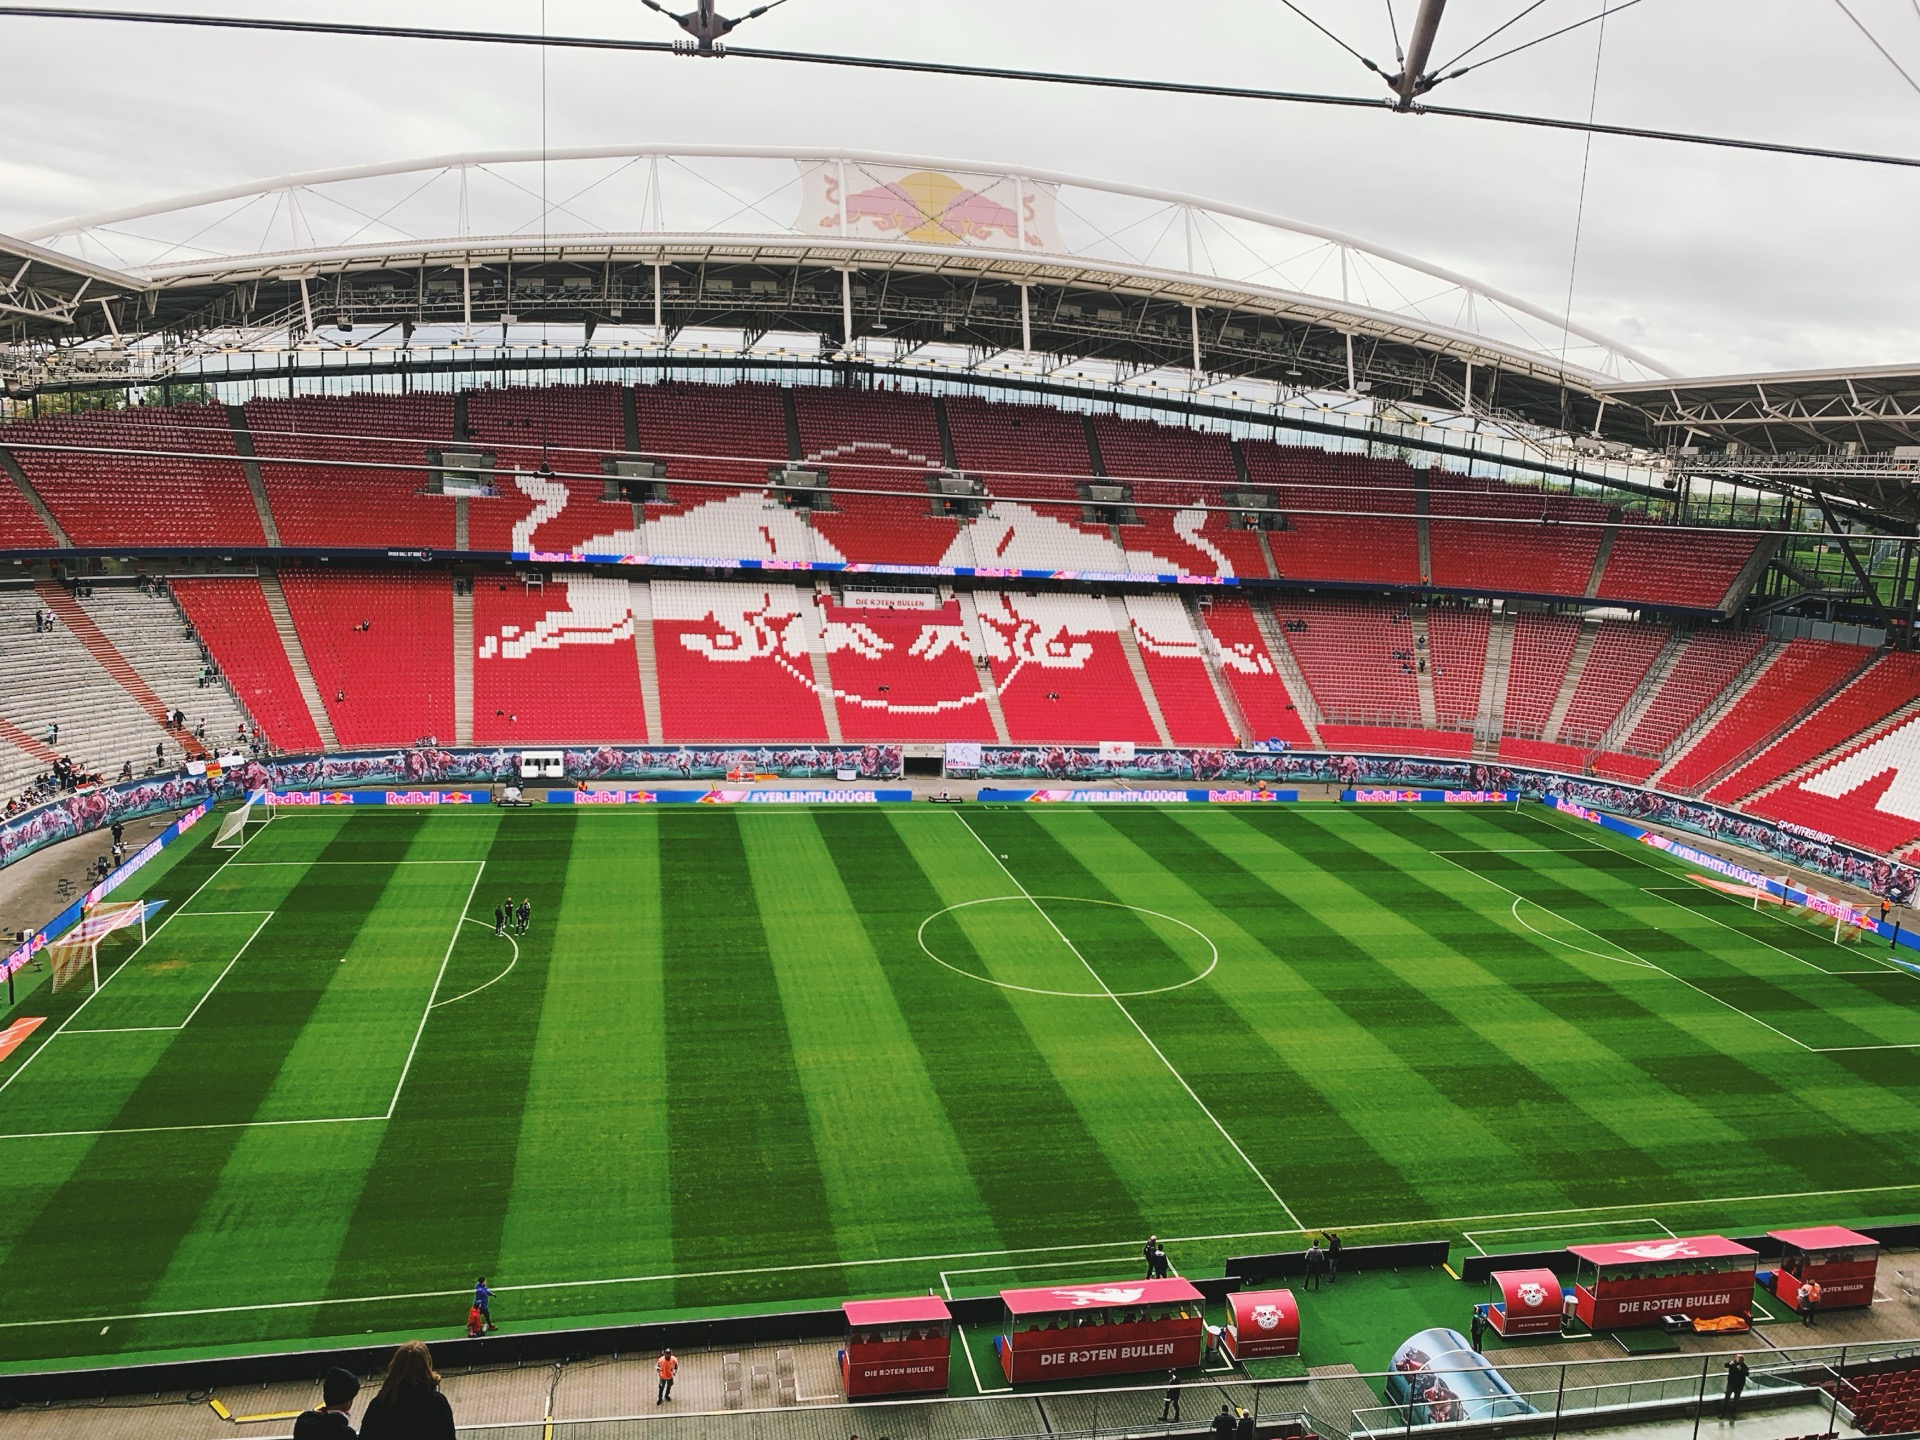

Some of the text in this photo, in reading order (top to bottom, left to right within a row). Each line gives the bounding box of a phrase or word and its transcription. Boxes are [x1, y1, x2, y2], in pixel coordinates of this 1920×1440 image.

[293, 792, 320, 804] Bull
[386, 792, 439, 804] Red Bull
[575, 791, 625, 803] Red Bull
[1209, 791, 1251, 802] Red Bull
[1356, 791, 1397, 802] Red Bull
[1445, 791, 1484, 802] Red Bull
[1619, 1294, 1730, 1313] DIE ROTEN BULLEN
[1041, 1343, 1174, 1366] DIE ROTEN BULLEN
[906, 1366, 934, 1374] BULLEN
